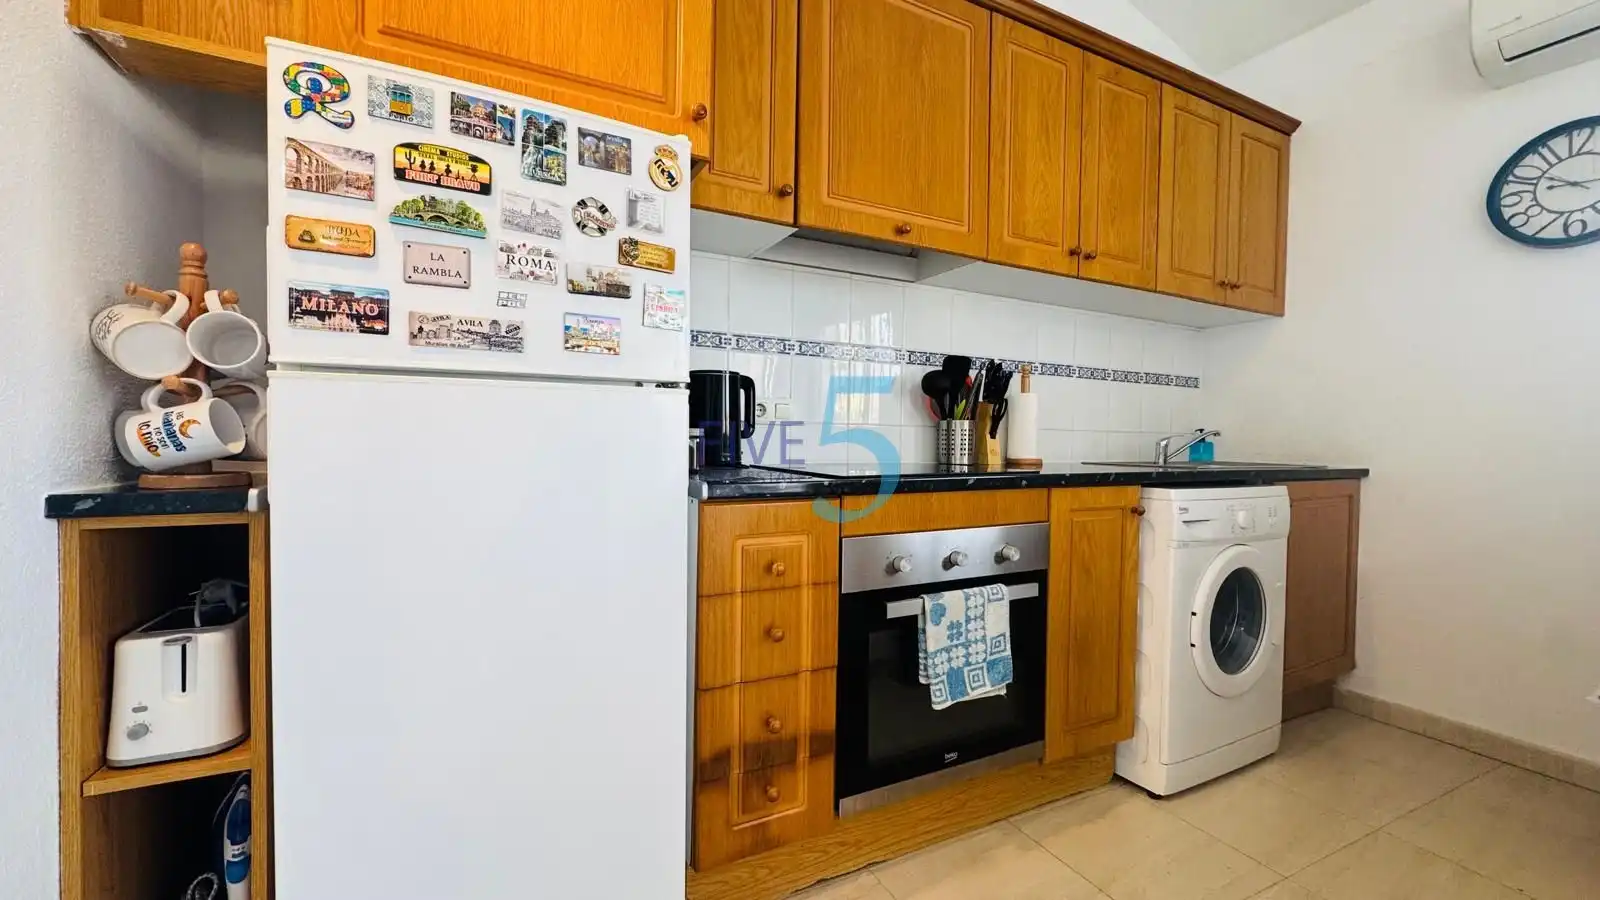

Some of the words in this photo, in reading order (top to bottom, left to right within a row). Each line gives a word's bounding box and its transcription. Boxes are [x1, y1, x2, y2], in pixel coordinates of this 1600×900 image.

[430, 252, 445, 262] LA
[506, 254, 553, 271] ROMA
[412, 265, 463, 279] RAMBLA
[300, 296, 379, 316] MILANO
